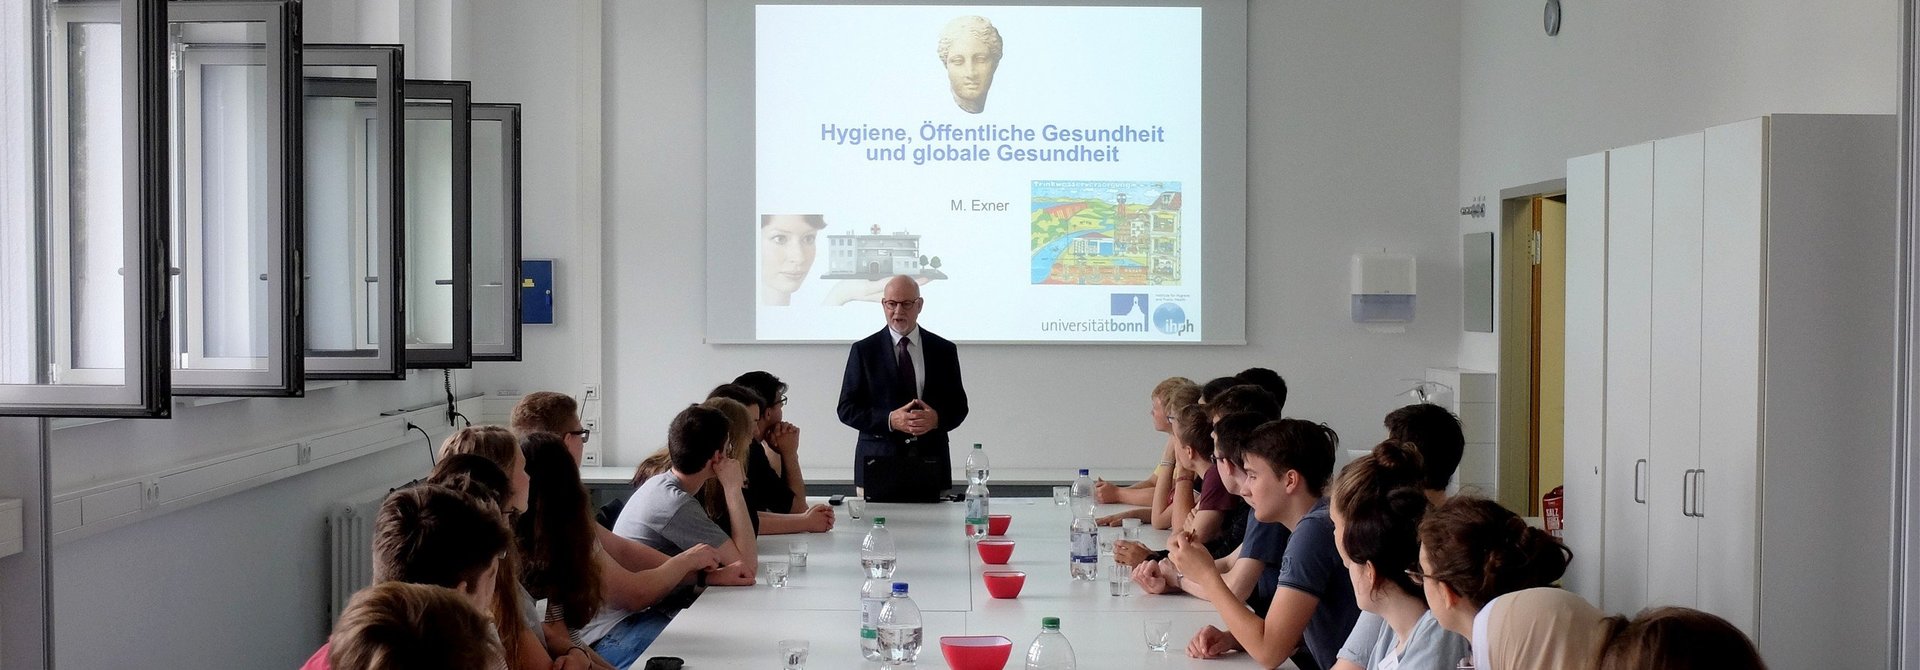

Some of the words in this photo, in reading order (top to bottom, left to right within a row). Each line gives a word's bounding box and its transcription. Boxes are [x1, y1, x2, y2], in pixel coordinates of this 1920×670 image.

[820, 124, 912, 144] Hygiene,
[919, 121, 1036, 142] Öffentliche
[1042, 125, 1165, 142] Gesundheit
[866, 145, 905, 161] und
[912, 145, 990, 165] globale
[997, 145, 1119, 162] Gesundheit
[951, 200, 966, 212] M.
[971, 200, 1009, 212] Exner
